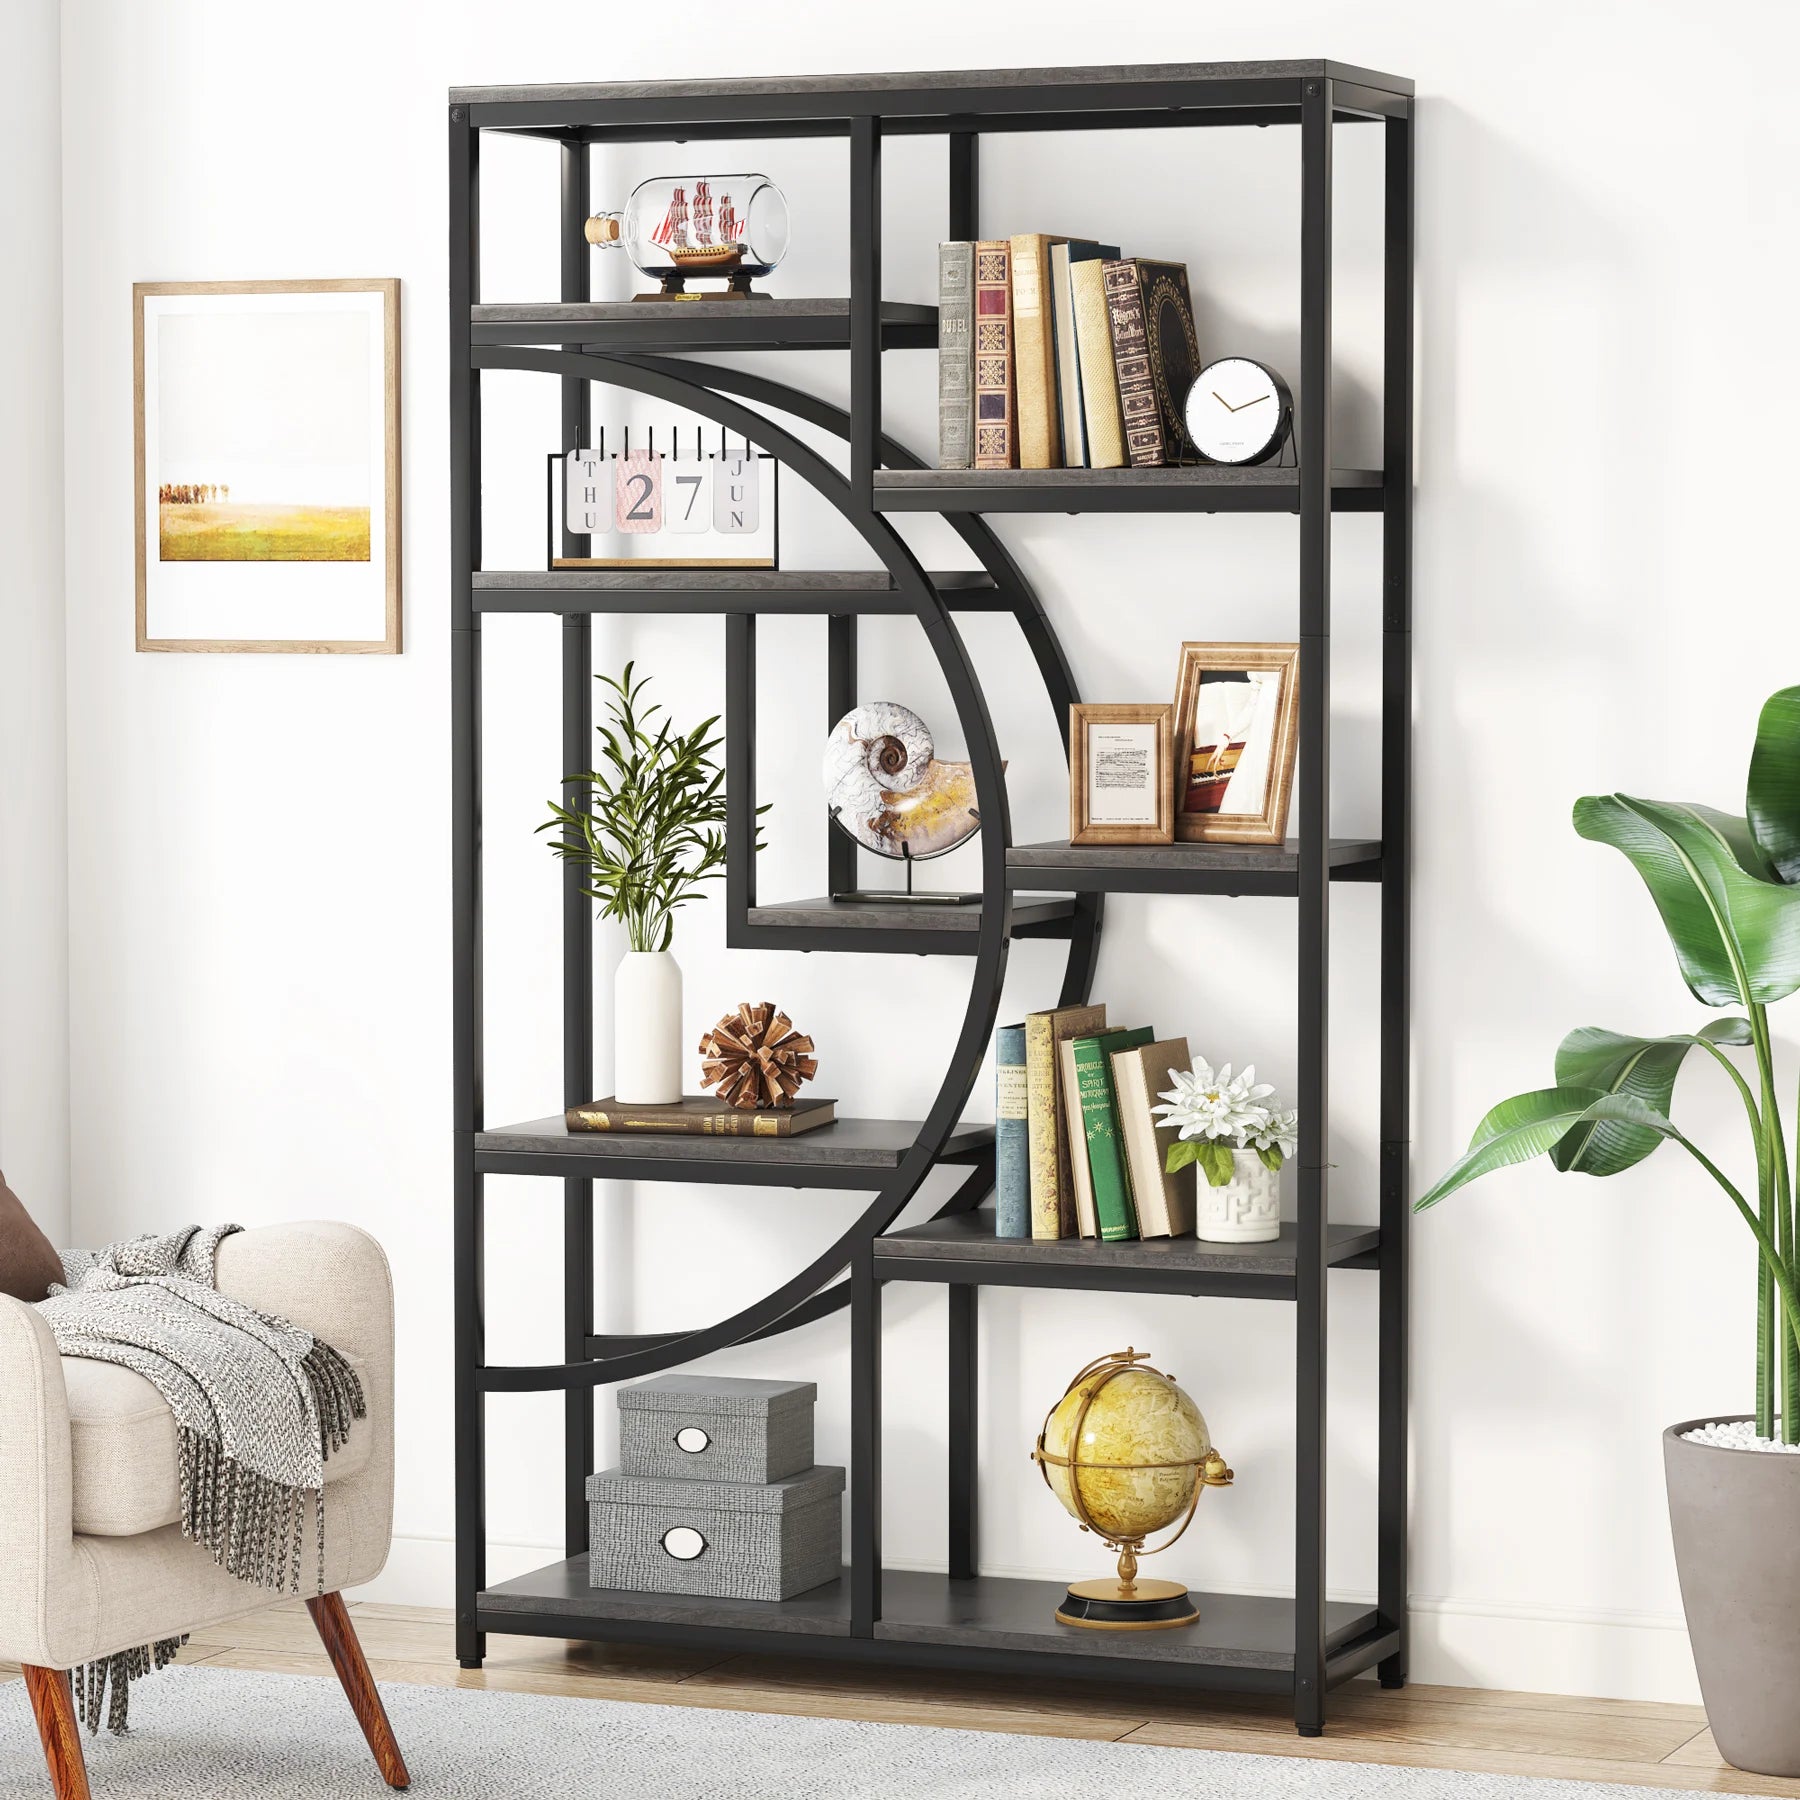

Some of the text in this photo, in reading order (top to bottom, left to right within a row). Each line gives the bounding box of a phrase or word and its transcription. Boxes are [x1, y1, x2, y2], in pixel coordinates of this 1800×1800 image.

[583, 461, 597, 529] THU
[729, 459, 745, 528] JUN
[1082, 1077, 1105, 1089] SPIRIT
